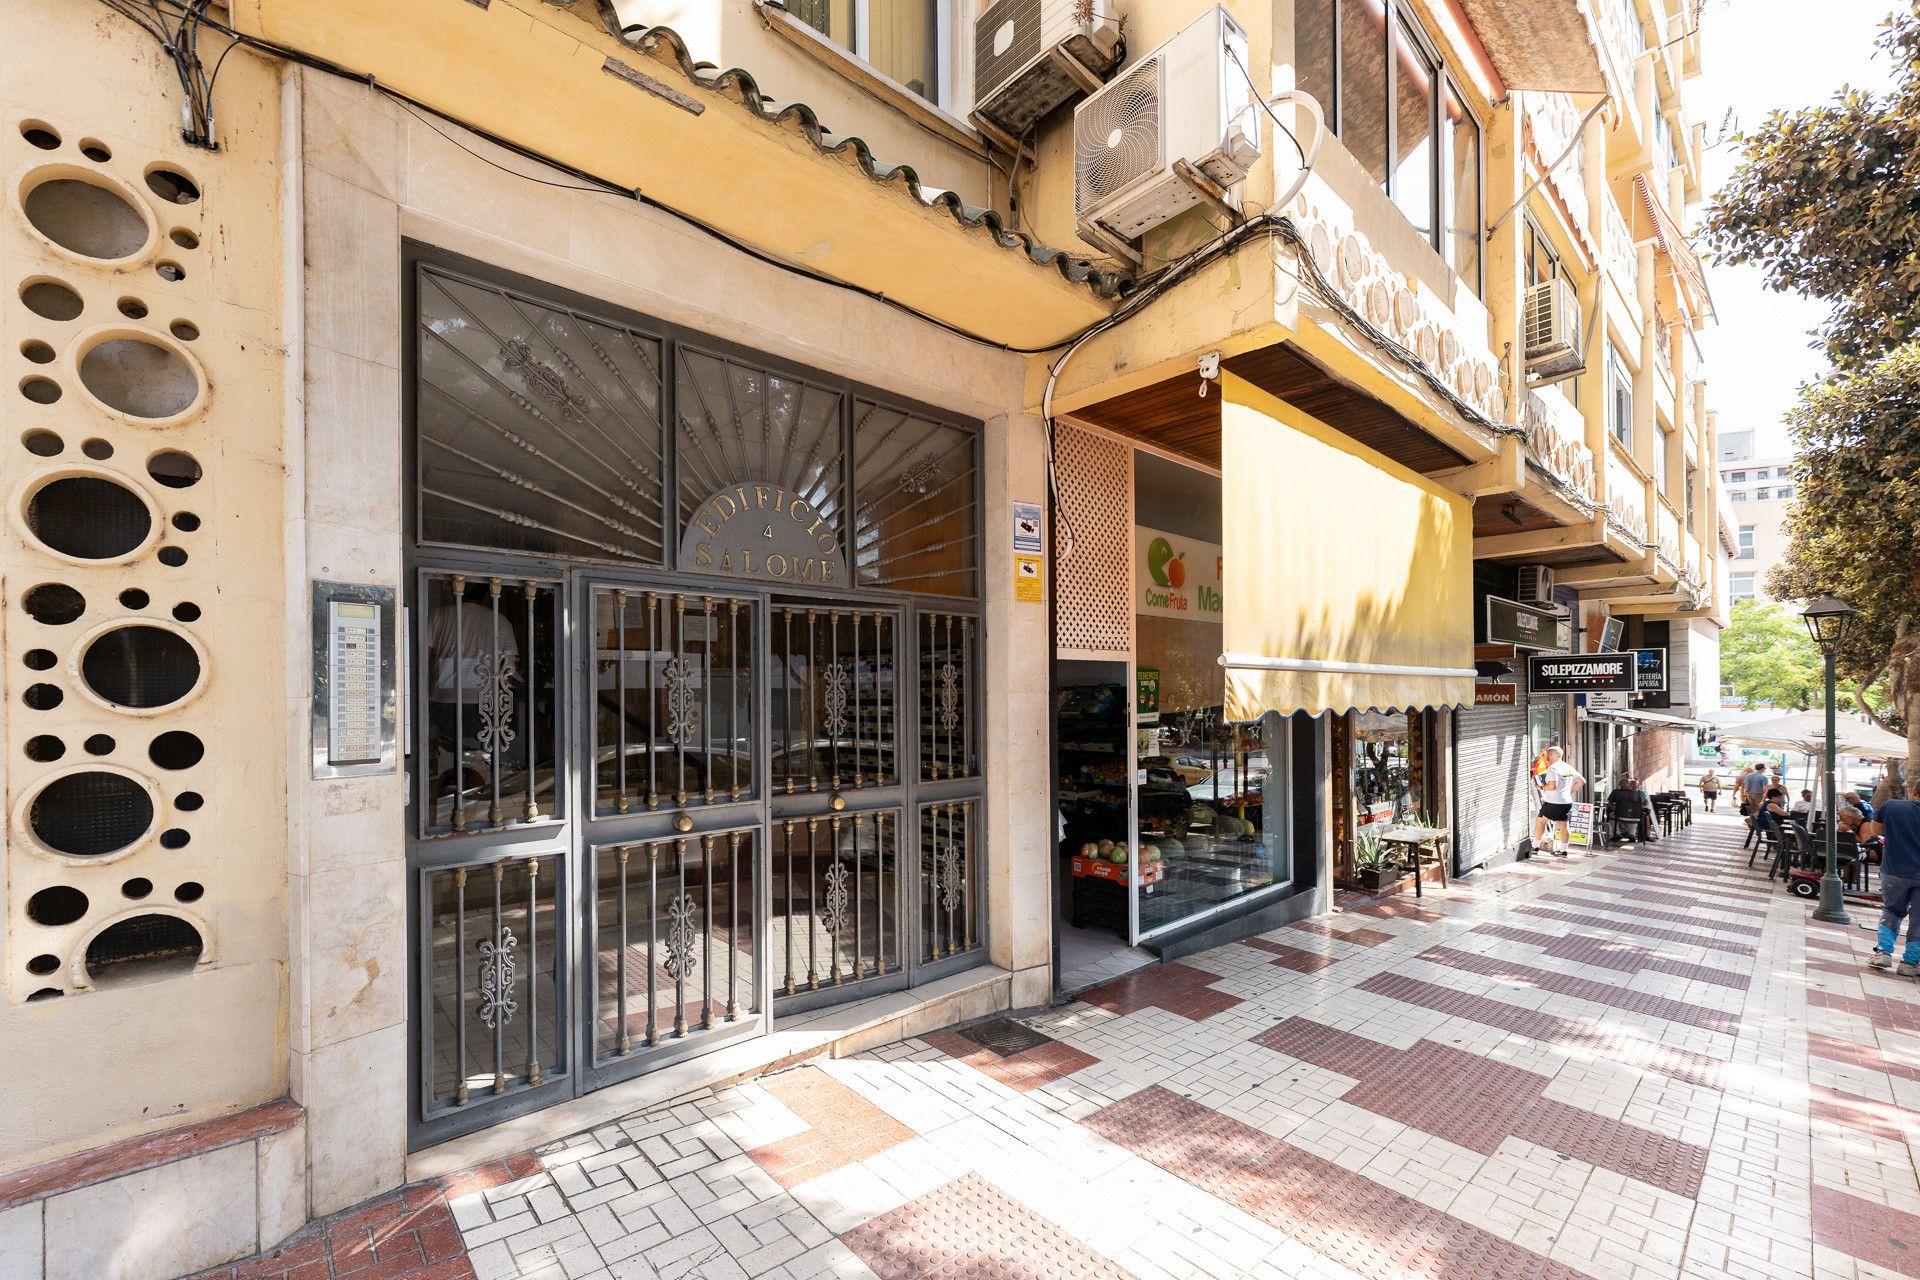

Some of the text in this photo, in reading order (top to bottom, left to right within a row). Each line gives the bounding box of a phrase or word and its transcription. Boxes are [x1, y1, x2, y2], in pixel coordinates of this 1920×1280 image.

[694, 486, 837, 555] EDIFICIO
[763, 524, 773, 538] 4
[696, 543, 835, 582] SALOME
[1145, 587, 1188, 611] ComeFruta
[1541, 662, 1623, 677] SOLEPIZZAMORE
[1475, 692, 1510, 702] AMÓN
